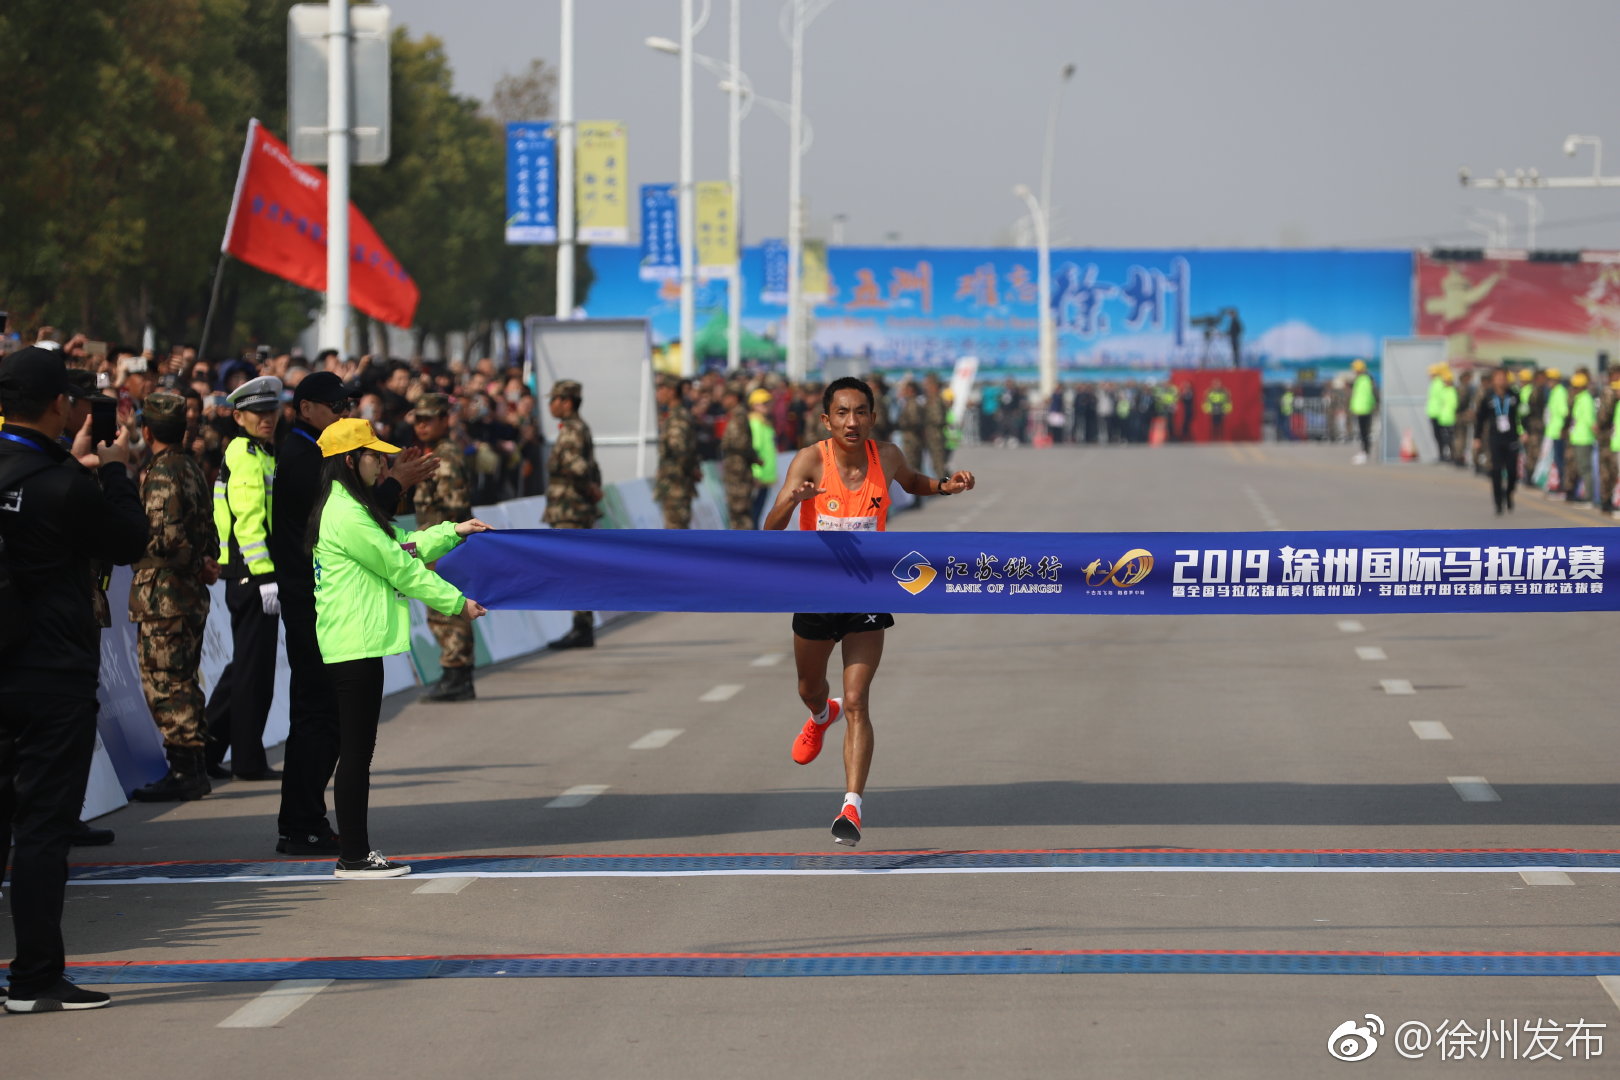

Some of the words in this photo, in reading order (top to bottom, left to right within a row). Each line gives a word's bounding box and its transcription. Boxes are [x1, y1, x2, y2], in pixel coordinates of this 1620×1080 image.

[945, 552, 1063, 581] 江苏银行
[1172, 549, 1270, 584] 2019
[1277, 544, 1606, 583] 徐州国际马拉松赛
[945, 584, 982, 593] BANK
[987, 584, 1005, 593] OF
[1009, 584, 1063, 595] JIANGSU
